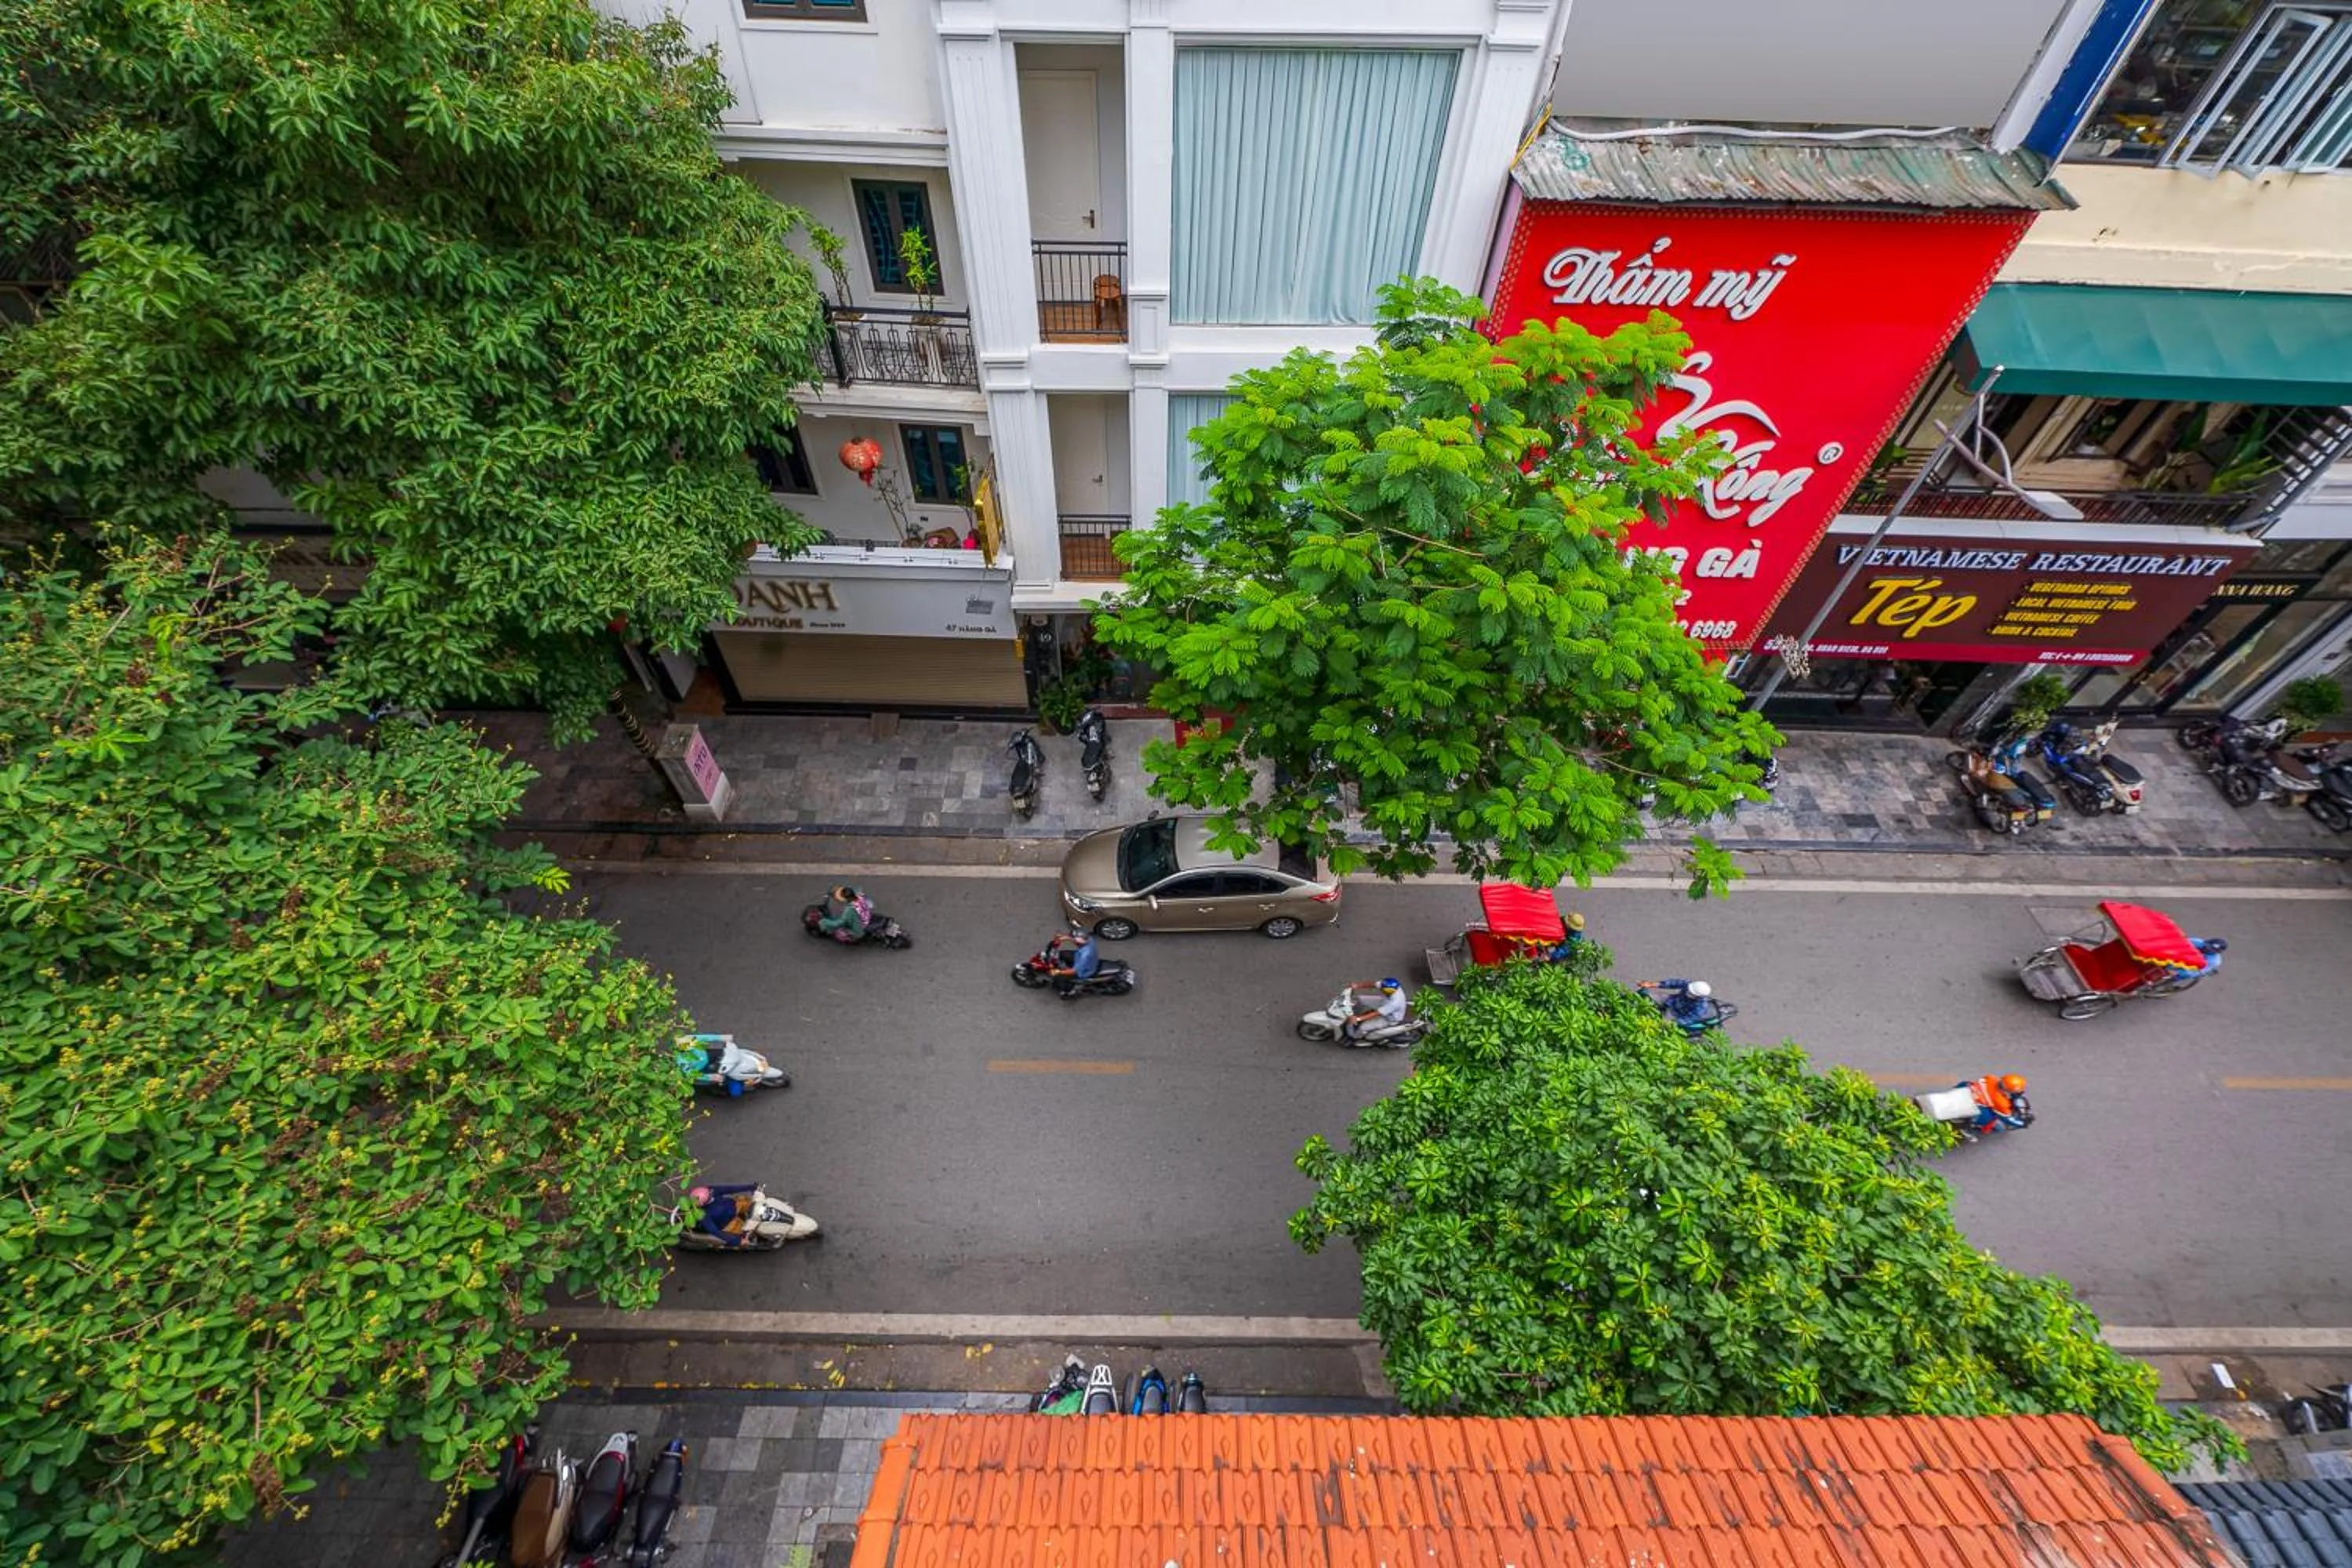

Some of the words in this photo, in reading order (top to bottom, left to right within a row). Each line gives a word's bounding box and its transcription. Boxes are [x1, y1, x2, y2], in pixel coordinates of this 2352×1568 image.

[1544, 236, 1693, 307] Thẩm
[1693, 253, 1798, 322] mỹ
[1696, 539, 1763, 579] GÀ
[1837, 546, 2028, 571] VETNAMESE
[2029, 552, 2233, 576] RESTAURANT
[1849, 579, 1978, 638] Tép
